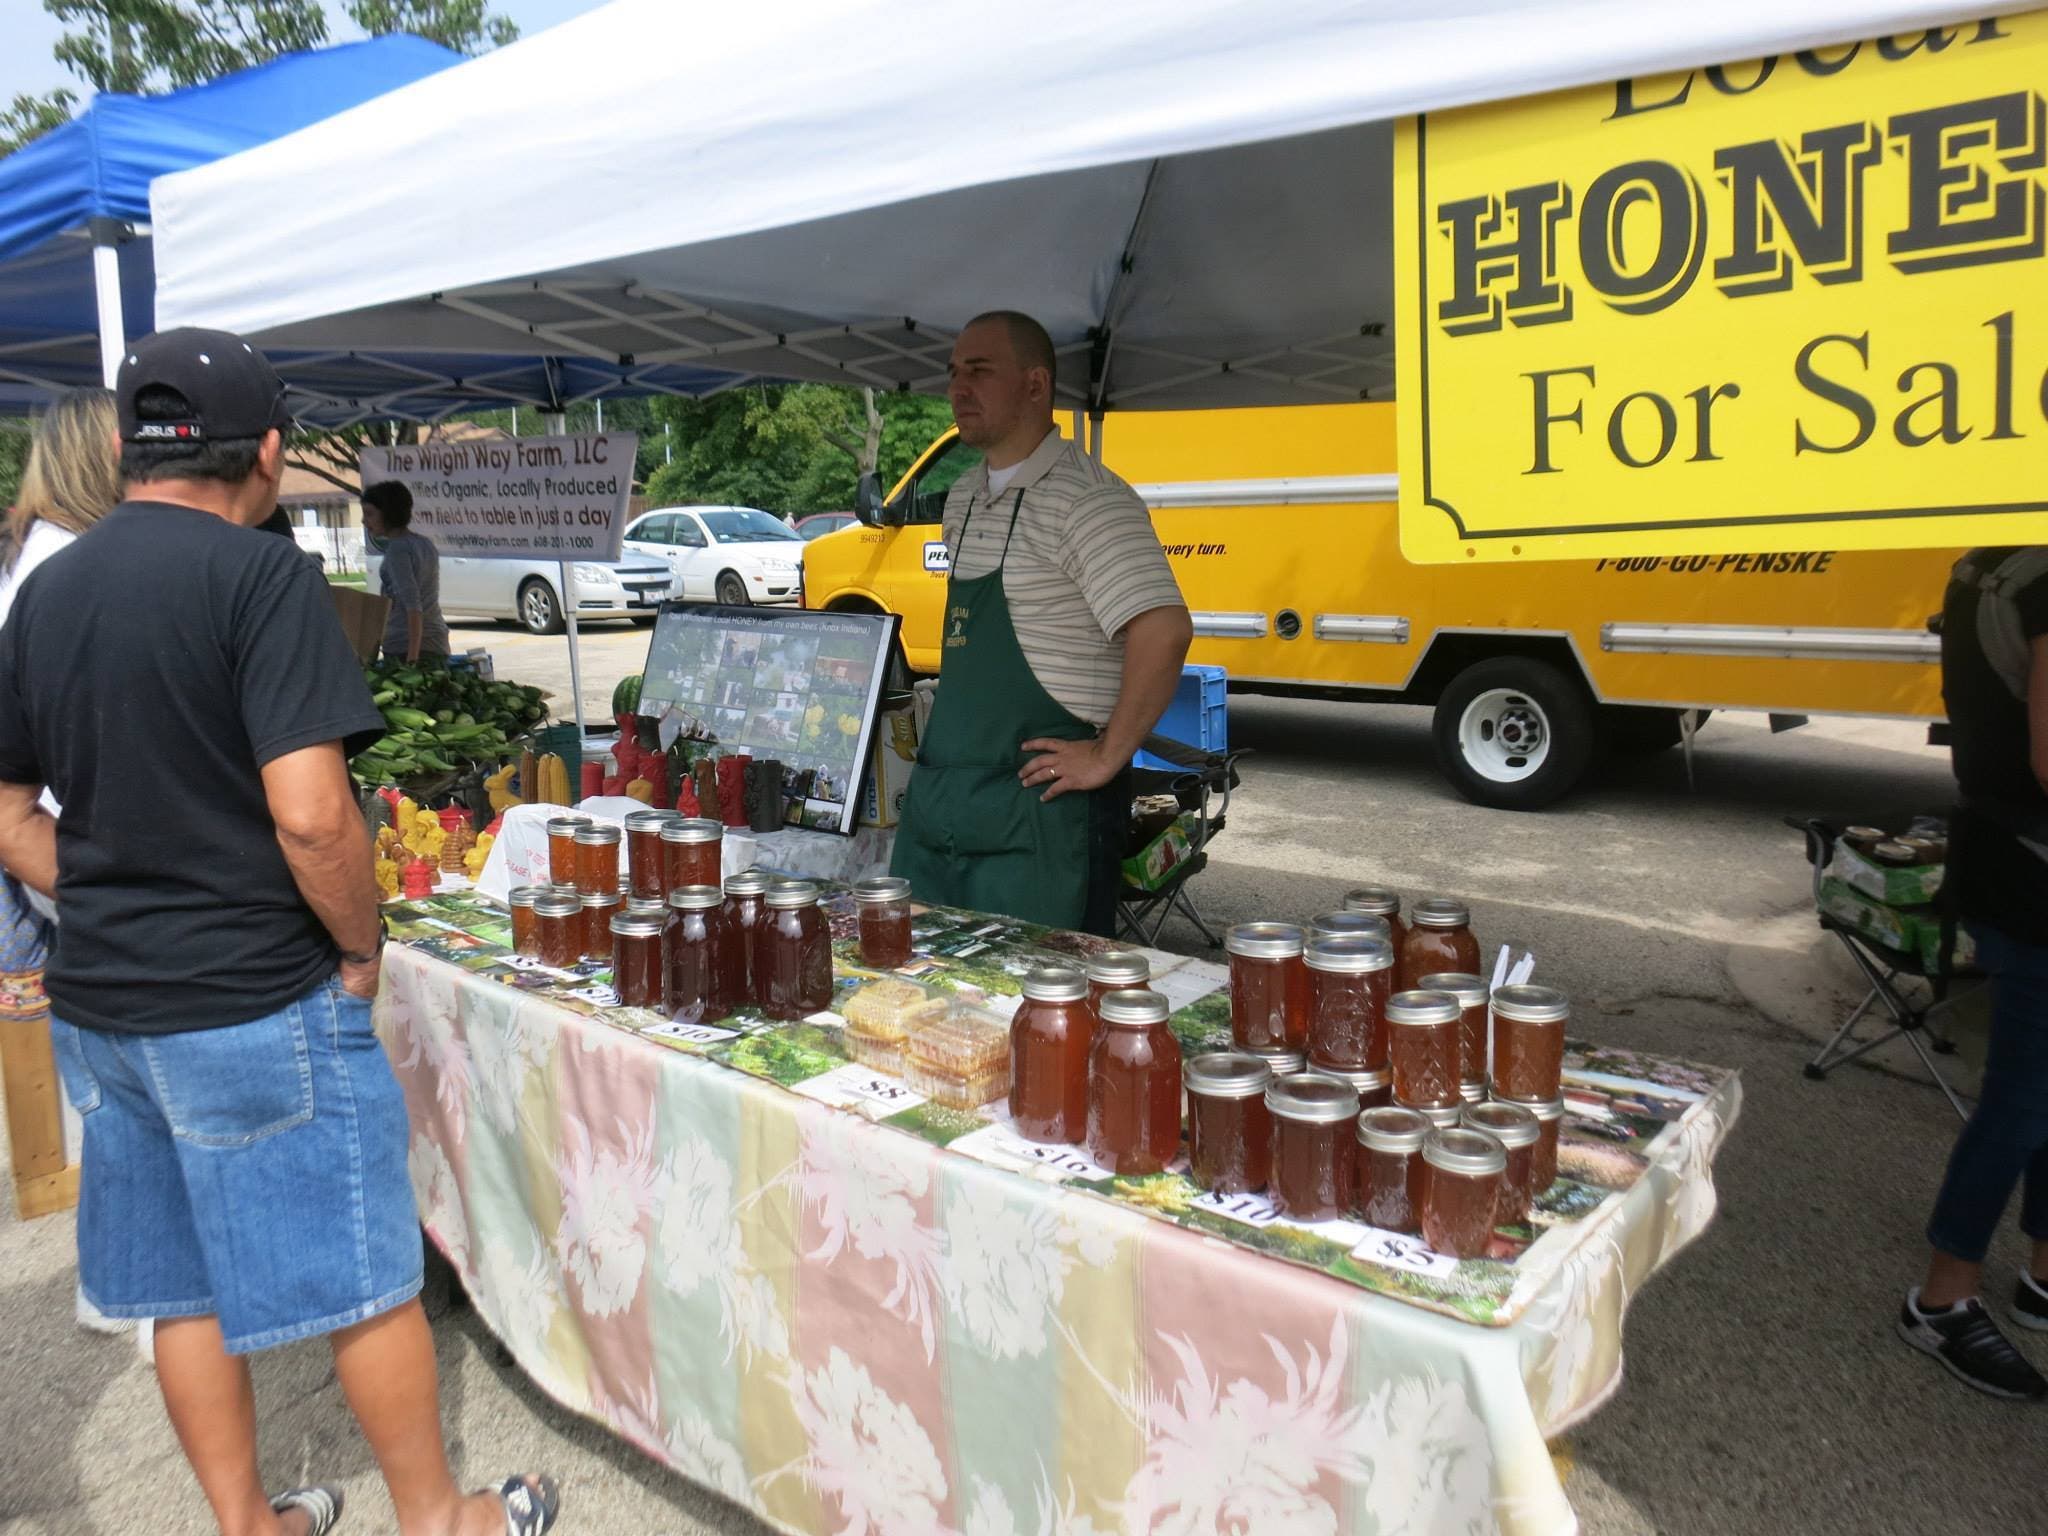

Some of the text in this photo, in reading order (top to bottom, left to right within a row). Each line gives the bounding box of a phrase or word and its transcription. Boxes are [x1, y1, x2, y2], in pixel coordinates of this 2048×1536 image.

[1520, 310, 2048, 475] For Sal
[134, 425, 200, 438] JESUS U
[385, 436, 609, 476] The Wright Way Farm, LLC
[497, 477, 541, 501] Locally
[545, 474, 618, 497] Produced
[436, 506, 463, 525] field
[464, 506, 479, 525] to
[480, 505, 517, 526] table
[518, 505, 534, 526] in
[535, 505, 560, 530] just
[563, 509, 574, 526] a
[578, 503, 612, 531] day
[1197, 542, 1227, 555] turn.
[1595, 550, 1836, 573] 1-800-GO-PENSKE
[731, 615, 757, 626] HONEY
